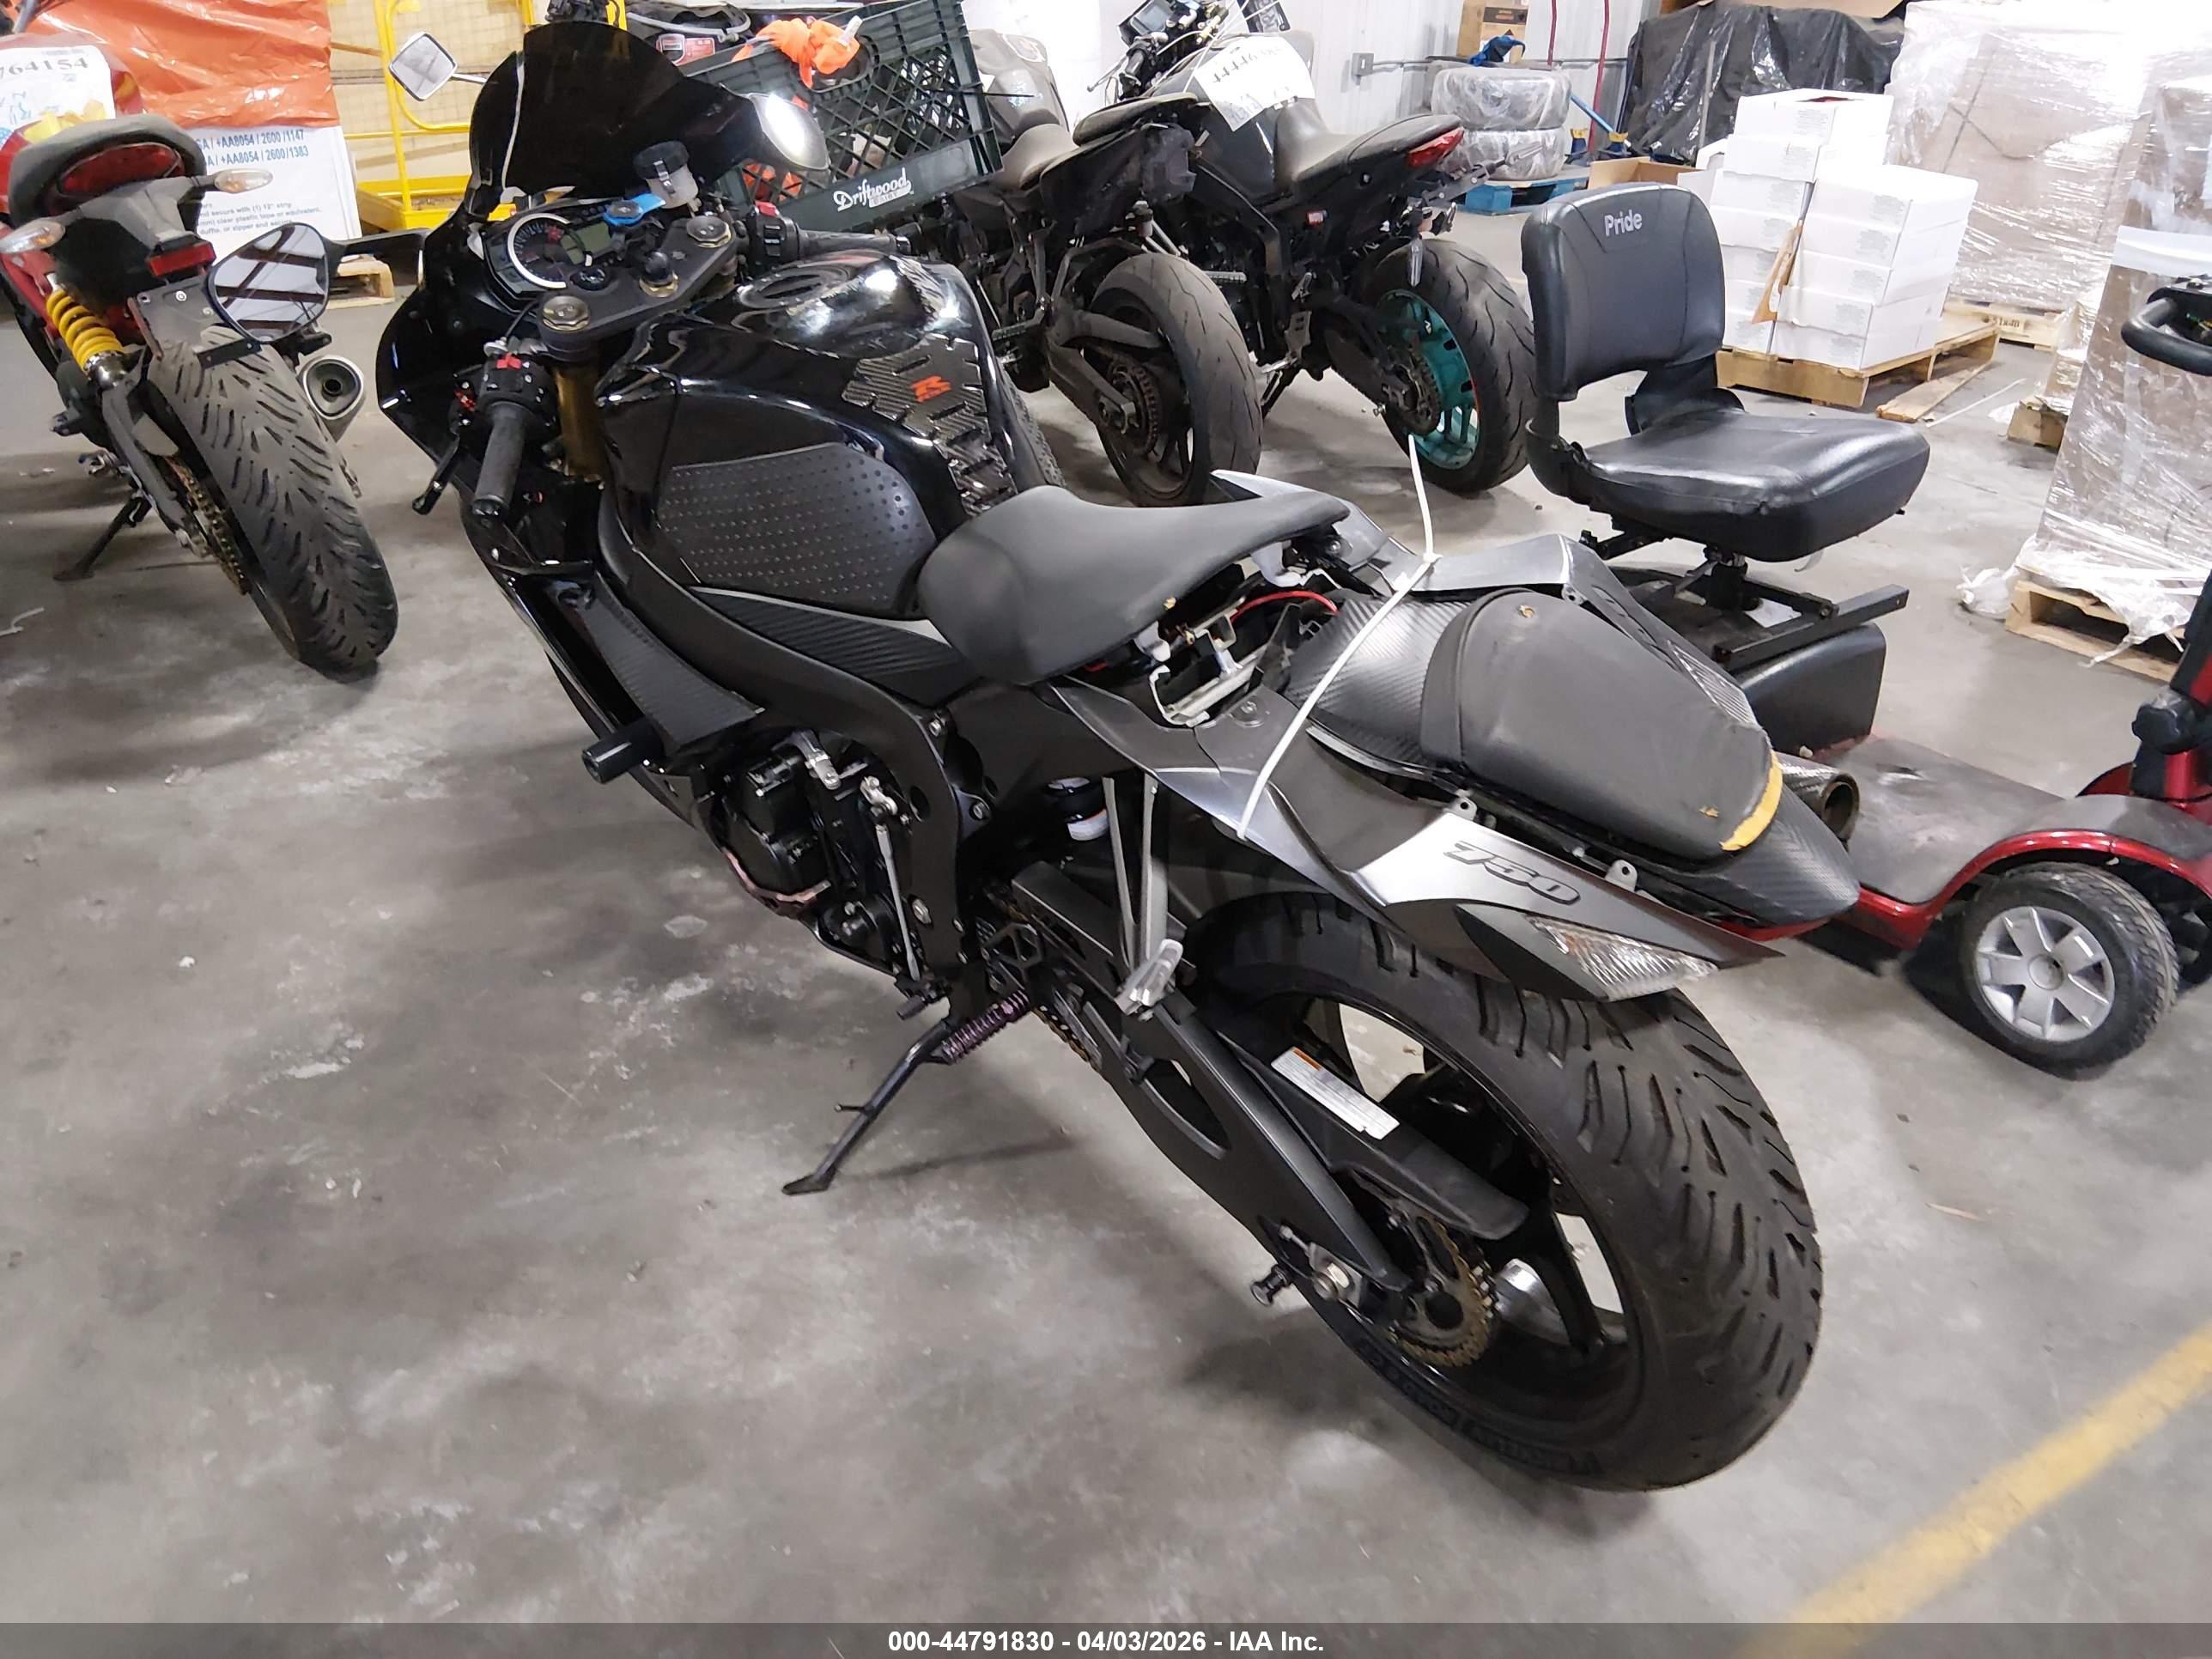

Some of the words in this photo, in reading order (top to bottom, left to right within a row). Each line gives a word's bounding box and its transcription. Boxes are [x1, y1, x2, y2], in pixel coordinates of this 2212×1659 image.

[833, 167, 908, 212] Driftwood
[235, 214, 258, 223] plastic
[1604, 209, 1643, 237] Pride
[1443, 841, 1582, 906] 750
